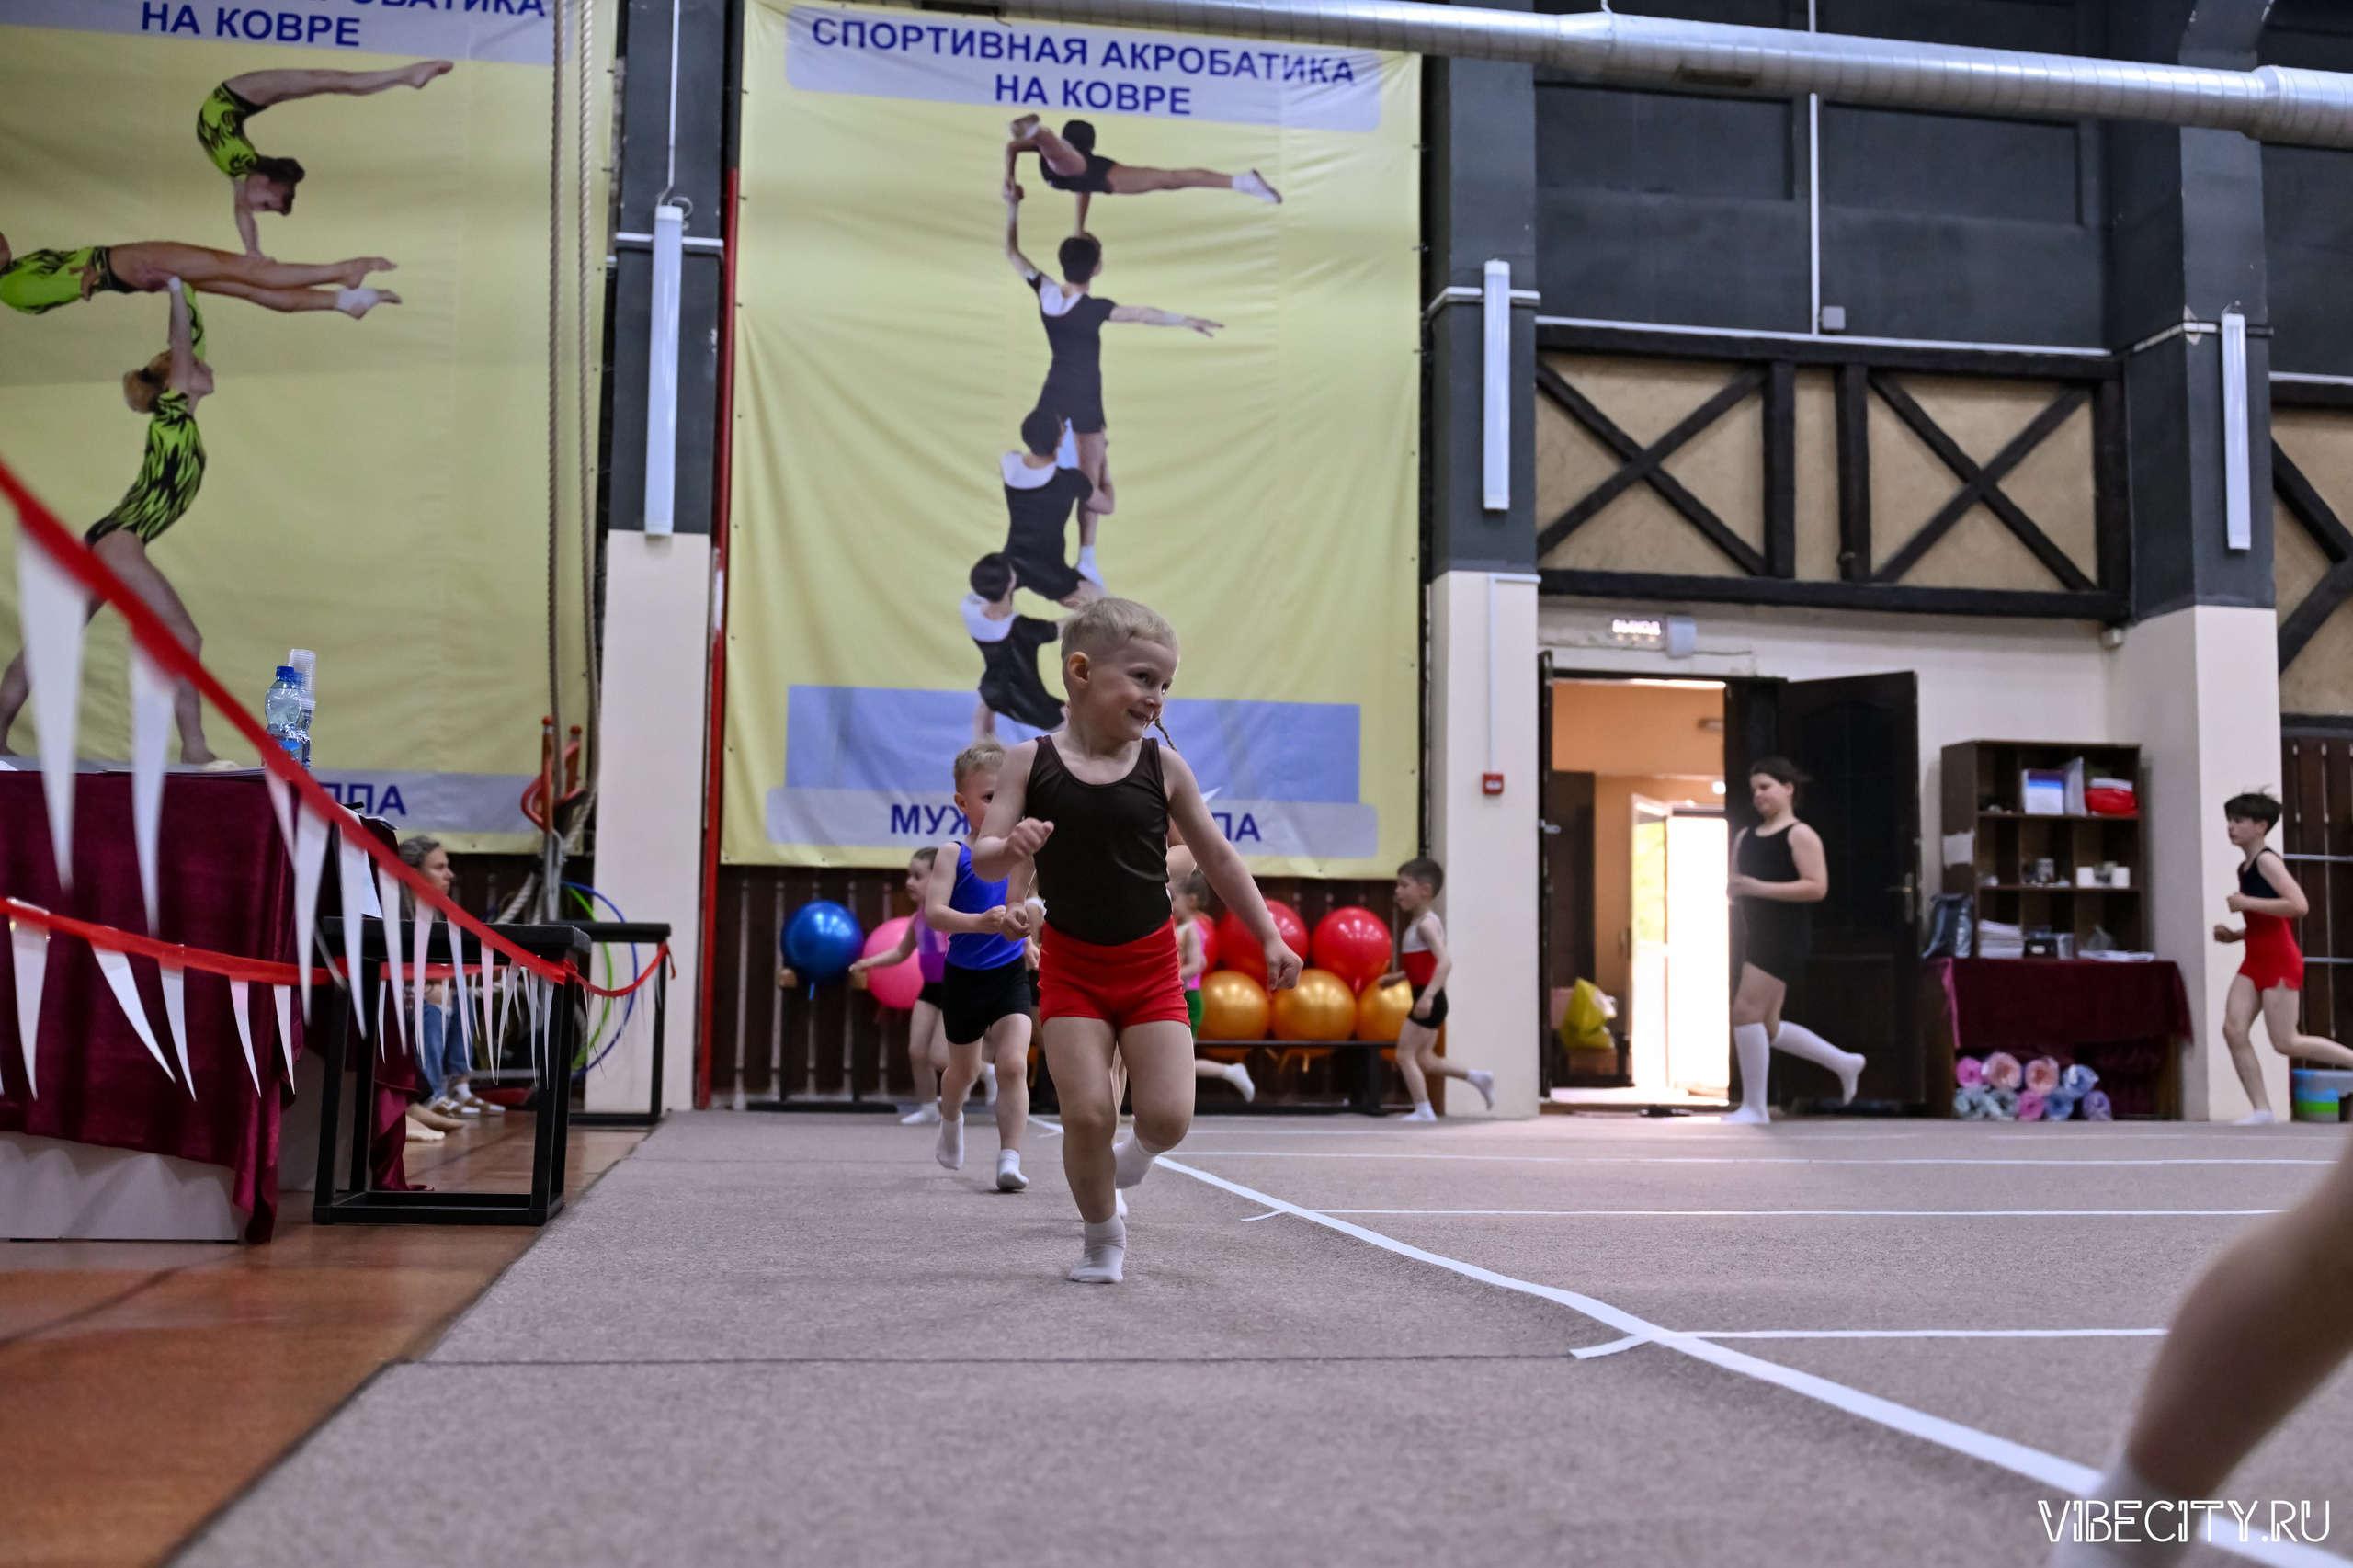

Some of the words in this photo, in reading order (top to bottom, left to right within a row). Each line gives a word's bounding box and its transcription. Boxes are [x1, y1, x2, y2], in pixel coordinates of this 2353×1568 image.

[142, 1, 201, 35] НА
[215, 7, 360, 47] КОВРЕ
[811, 17, 1088, 66] СПОРТИВНАЯ
[1100, 40, 1356, 85] АКРОБАТИКА
[995, 74, 1049, 105] НА
[1062, 79, 1191, 114] КОВРЕ
